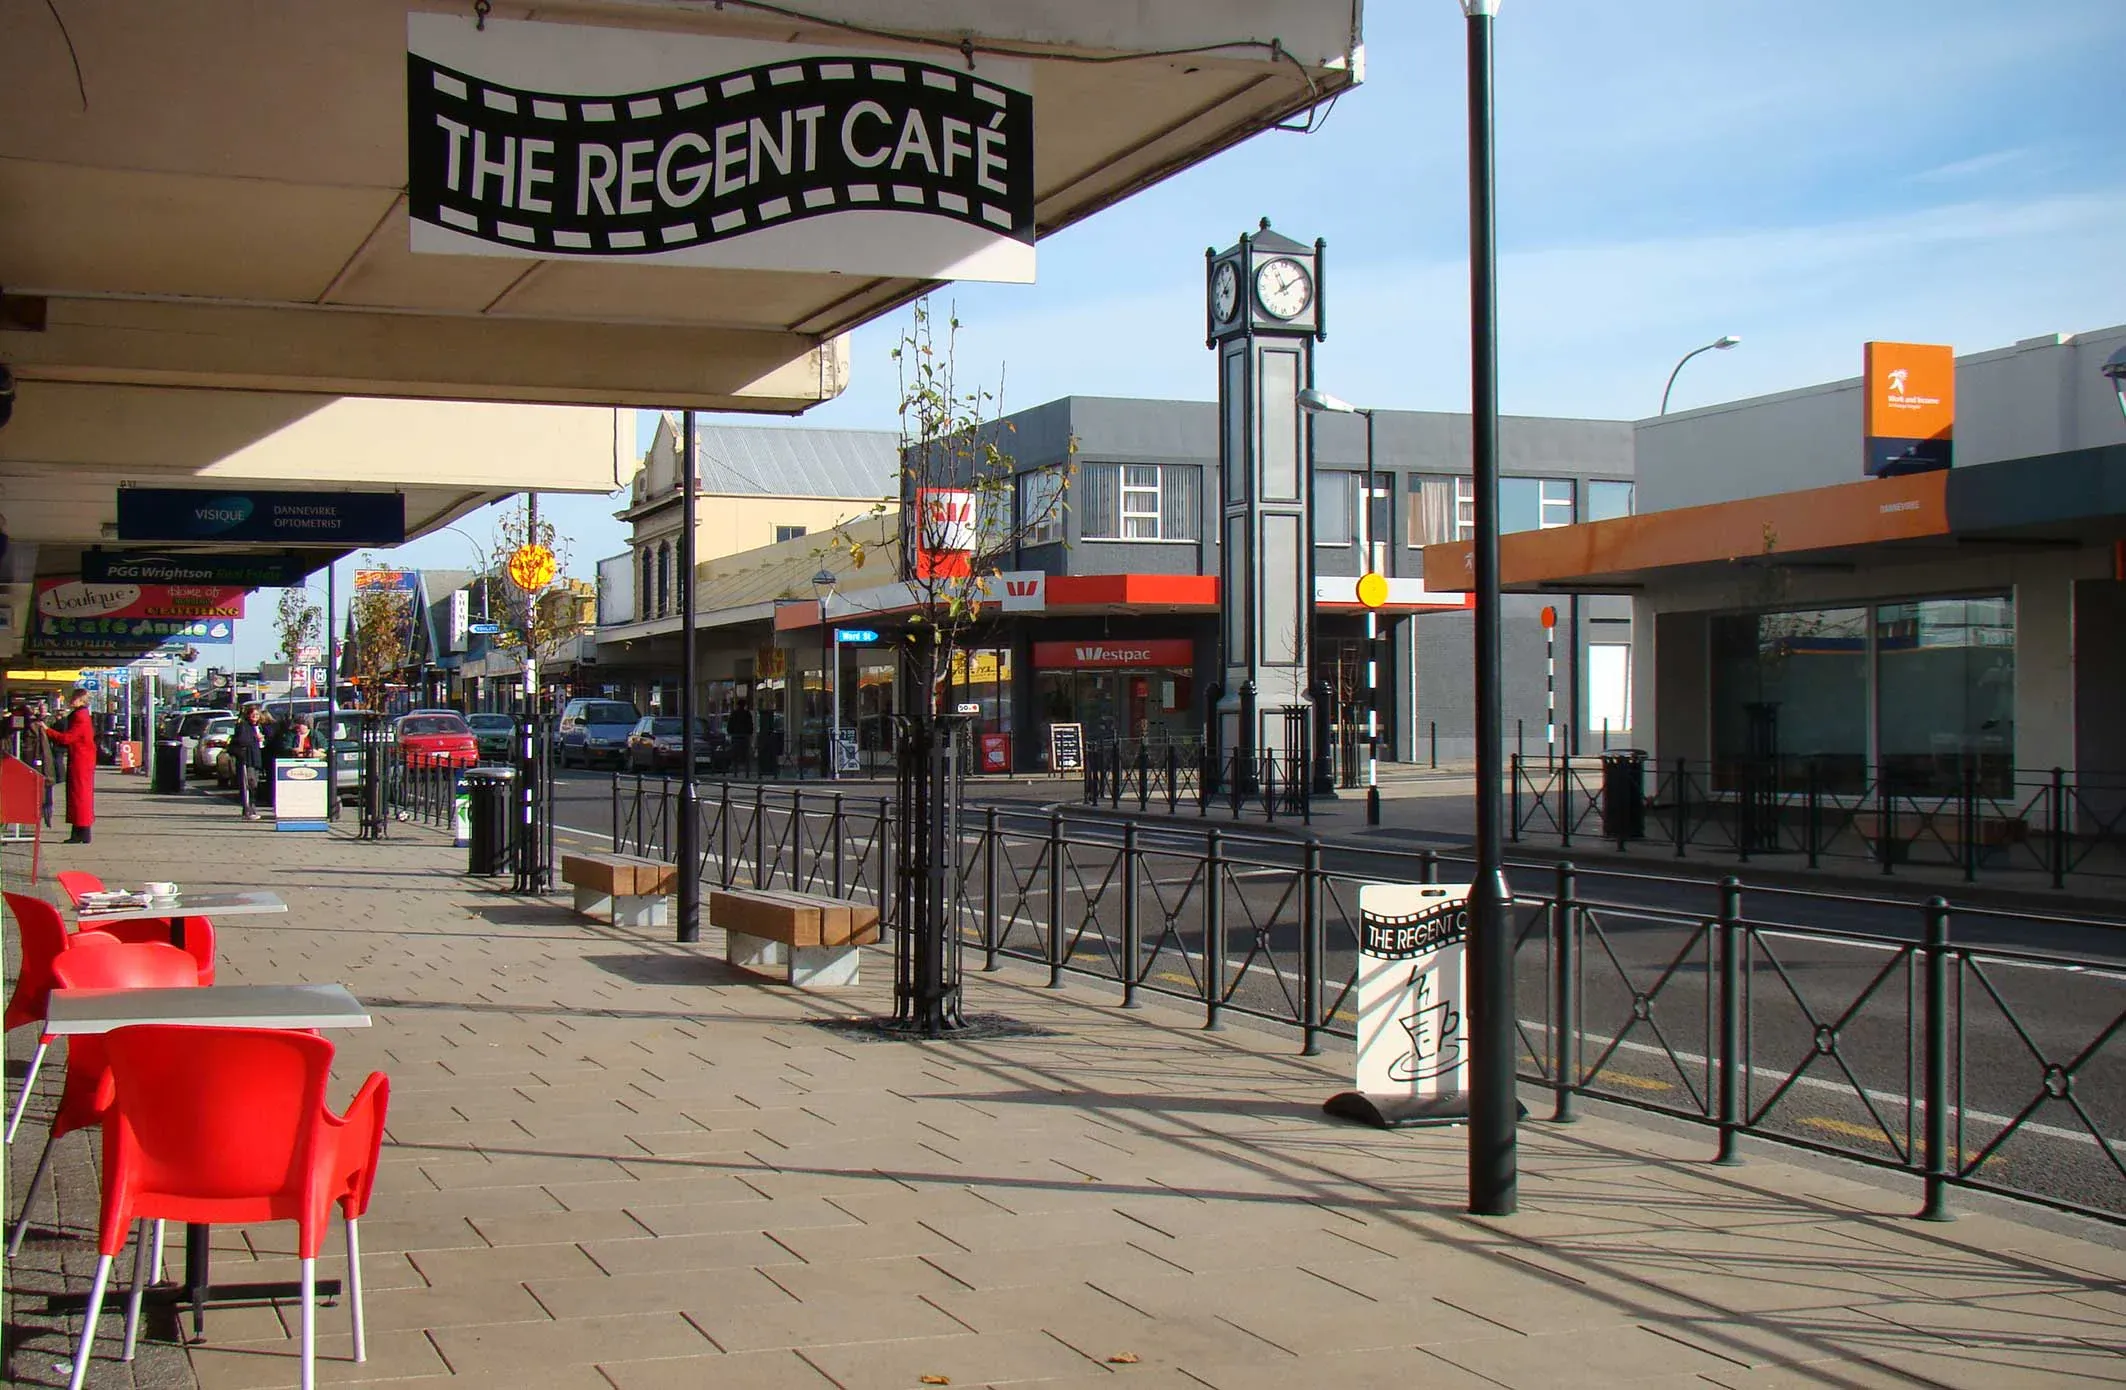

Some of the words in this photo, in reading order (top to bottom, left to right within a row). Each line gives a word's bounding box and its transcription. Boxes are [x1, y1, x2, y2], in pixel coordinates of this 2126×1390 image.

[436, 114, 554, 214] THE
[577, 105, 826, 216] REGENT
[841, 100, 1008, 196] CAFÉ
[195, 508, 245, 524] VISIQUE
[273, 505, 337, 517] DANNEVIRKE
[274, 518, 341, 529] OPTOMETRIST
[107, 566, 138, 577] PGG
[141, 567, 213, 580] Wrightson
[53, 587, 125, 610] boutique
[1075, 647, 1152, 663] Westpac
[1368, 924, 1394, 950] THE
[1396, 913, 1454, 951] REGENT
